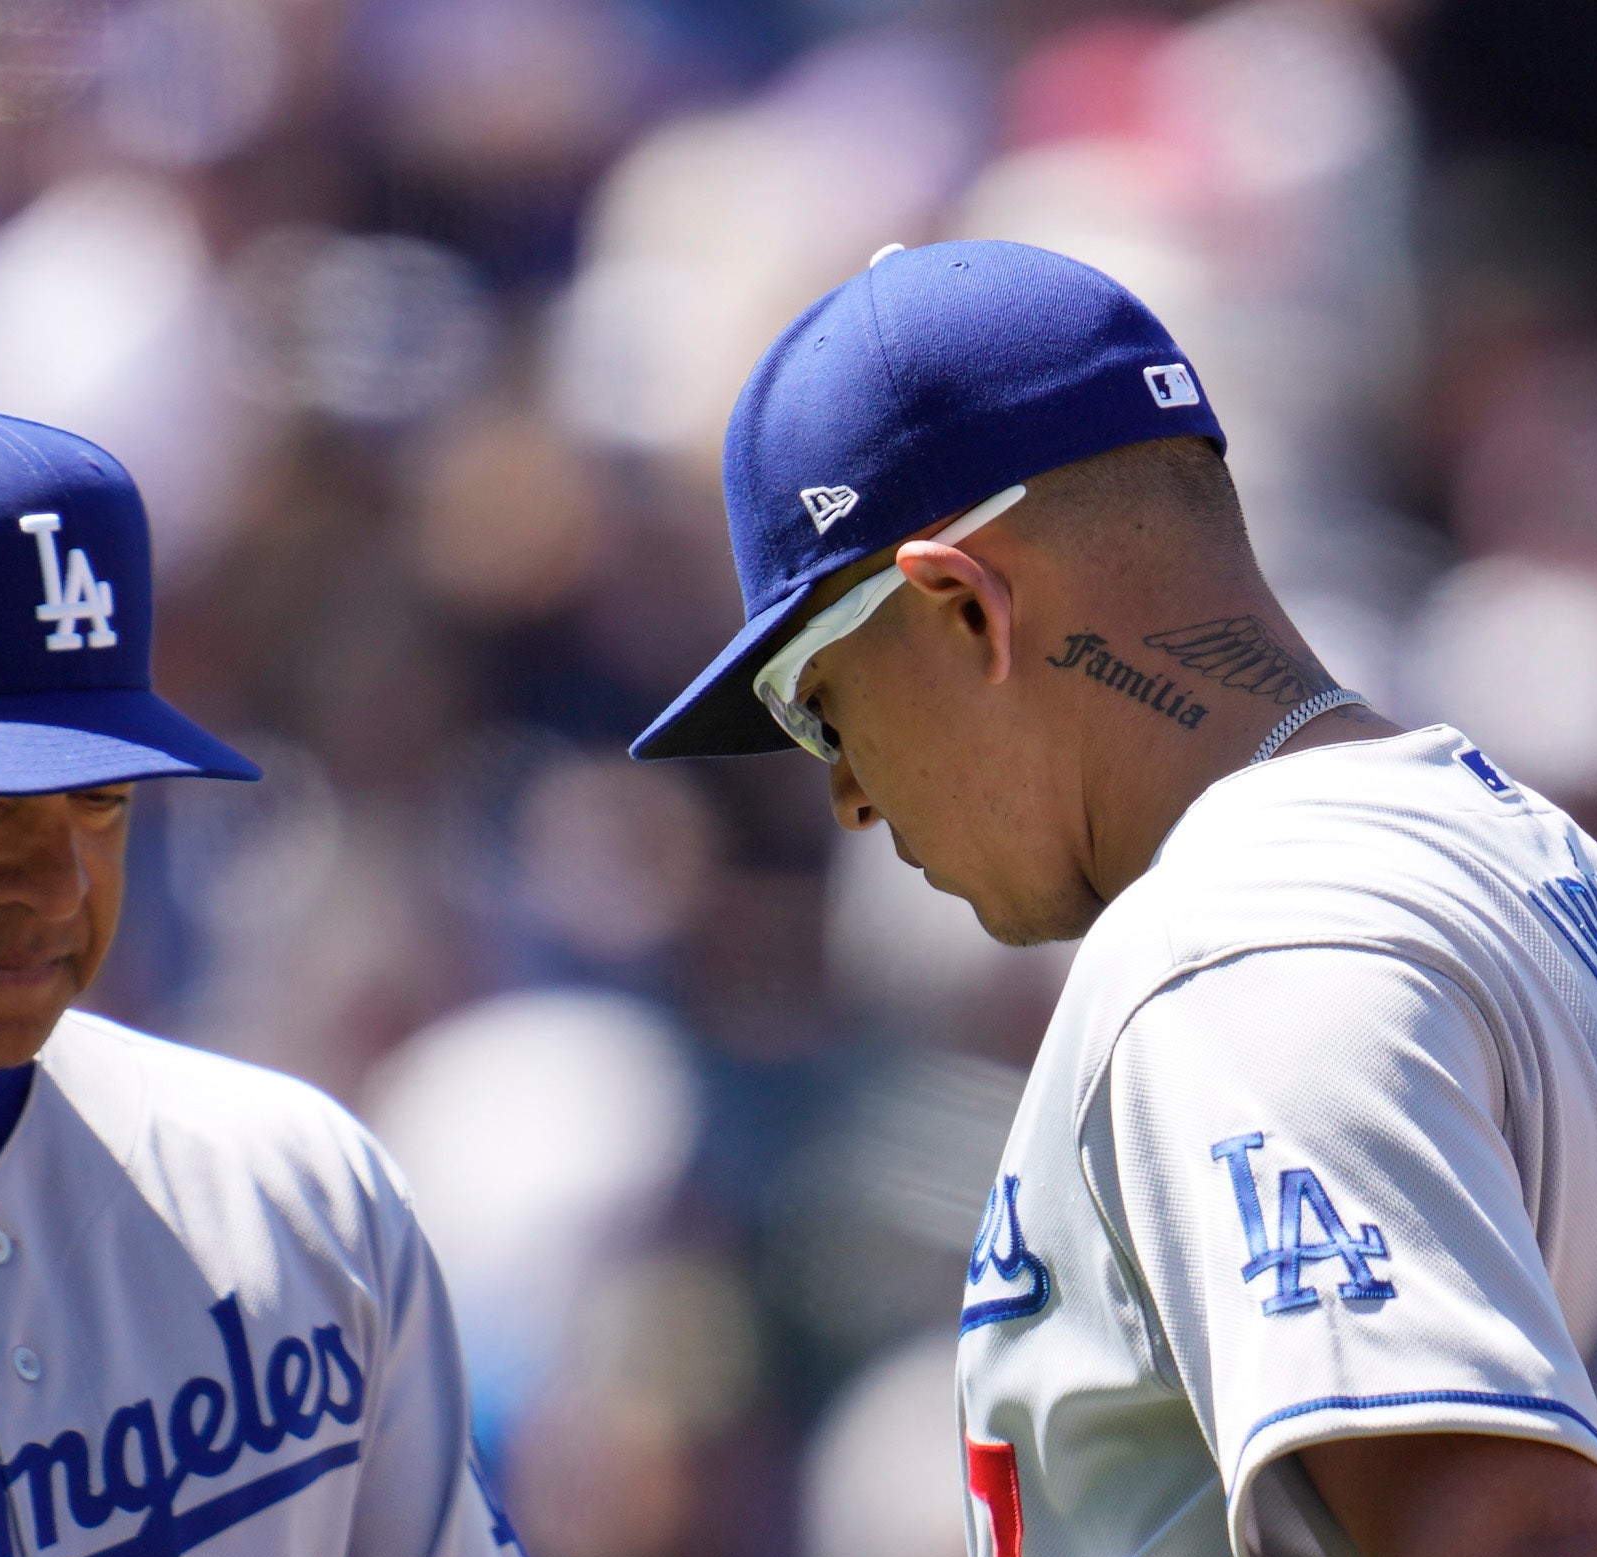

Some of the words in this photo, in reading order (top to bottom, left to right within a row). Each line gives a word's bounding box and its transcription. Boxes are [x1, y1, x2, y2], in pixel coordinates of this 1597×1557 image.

[19, 513, 118, 652] LA
[1046, 627, 1209, 730] Familia
[1211, 1131, 1398, 1317] LA
